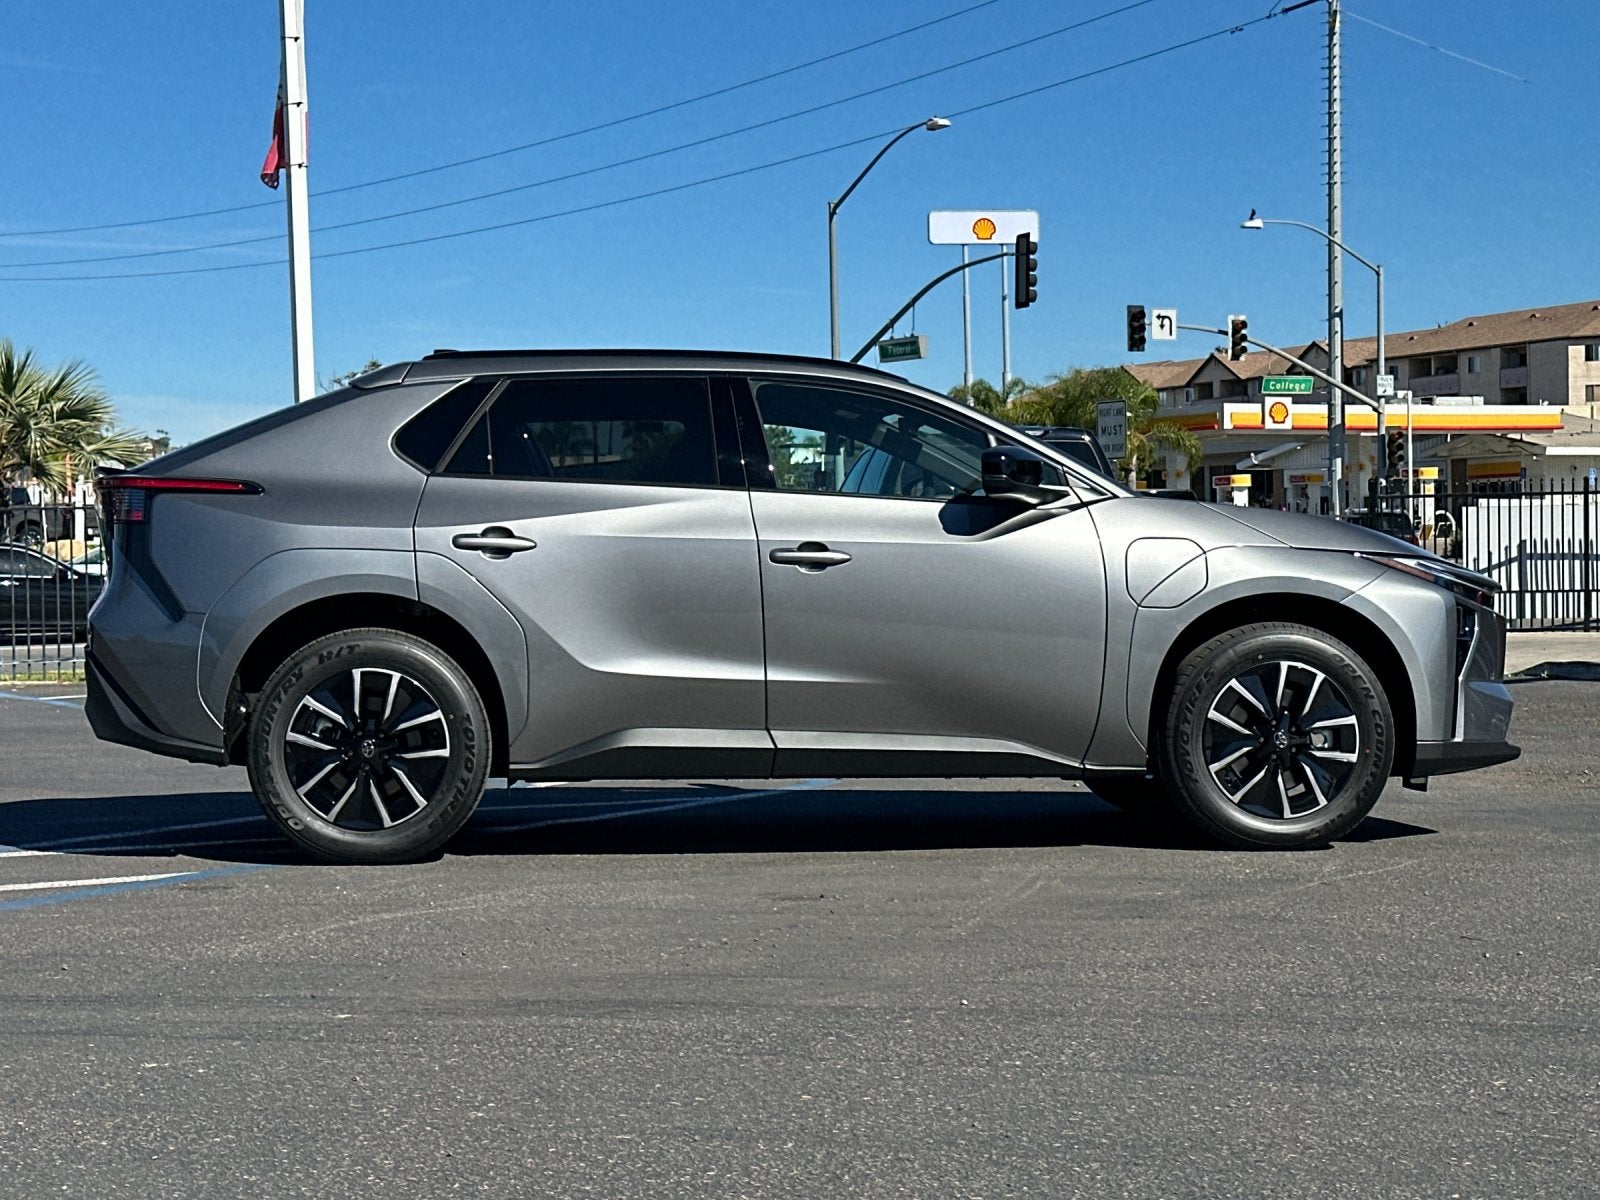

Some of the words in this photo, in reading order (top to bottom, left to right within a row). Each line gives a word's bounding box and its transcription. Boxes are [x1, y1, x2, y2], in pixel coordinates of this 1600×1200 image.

[1269, 381, 1306, 392] College
[1113, 407, 1125, 417] LANE
[1101, 425, 1123, 436] MUST
[1330, 653, 1375, 701] OPEN
[259, 666, 303, 768] COUNTRY
